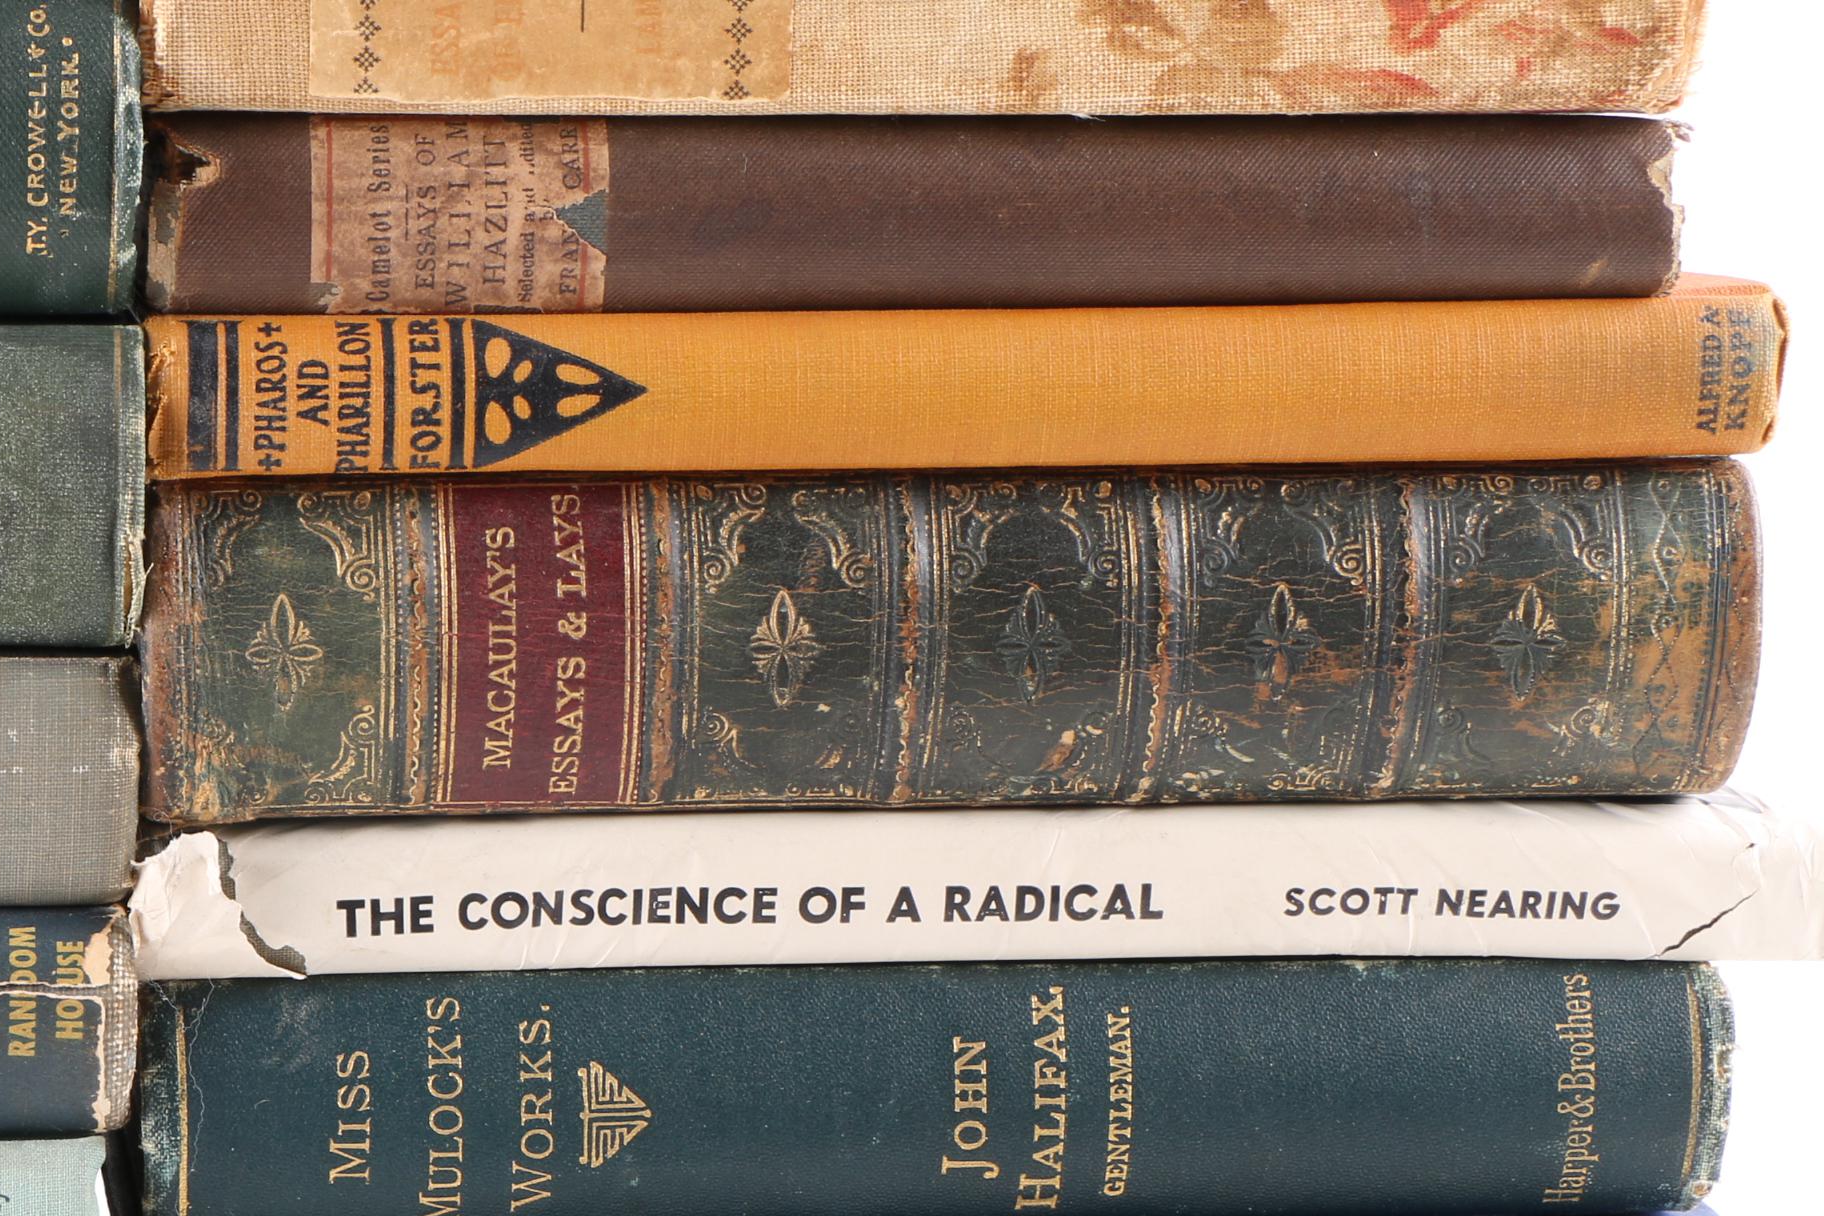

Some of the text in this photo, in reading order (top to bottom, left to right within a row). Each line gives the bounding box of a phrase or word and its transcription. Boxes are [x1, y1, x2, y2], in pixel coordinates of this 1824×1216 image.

[26, 64, 50, 208] CROWELL
[59, 153, 78, 217] NEW
[365, 123, 392, 303] Camelot Series
[414, 133, 438, 291] ESSAYS OF
[445, 120, 472, 307] WILLIAM
[482, 135, 509, 286] HAZLITT
[517, 231, 536, 303] Selected
[296, 358, 329, 426] AND
[336, 320, 372, 473] PHARILLON
[408, 317, 444, 471] FORSTER
[1695, 334, 1723, 435] ALFRED
[1723, 309, 1754, 431] KNOPF
[482, 525, 517, 770] MACAULAY'S
[557, 611, 587, 641] &
[549, 656, 586, 796] ESSAYS
[336, 882, 1165, 938] THE CONSCIENCE OF A RADICAL
[1283, 886, 1622, 921] SCOTT NEARING
[7, 926, 38, 1057] RANDOM
[55, 940, 86, 1041] HOUSE
[327, 1049, 374, 1186] MISS
[509, 1003, 555, 1214] WORKS.
[940, 1034, 1001, 1180] JOHN
[1102, 1004, 1134, 1197] GENTLEMAN.
[1541, 971, 1601, 1204] Harper & Brothers
